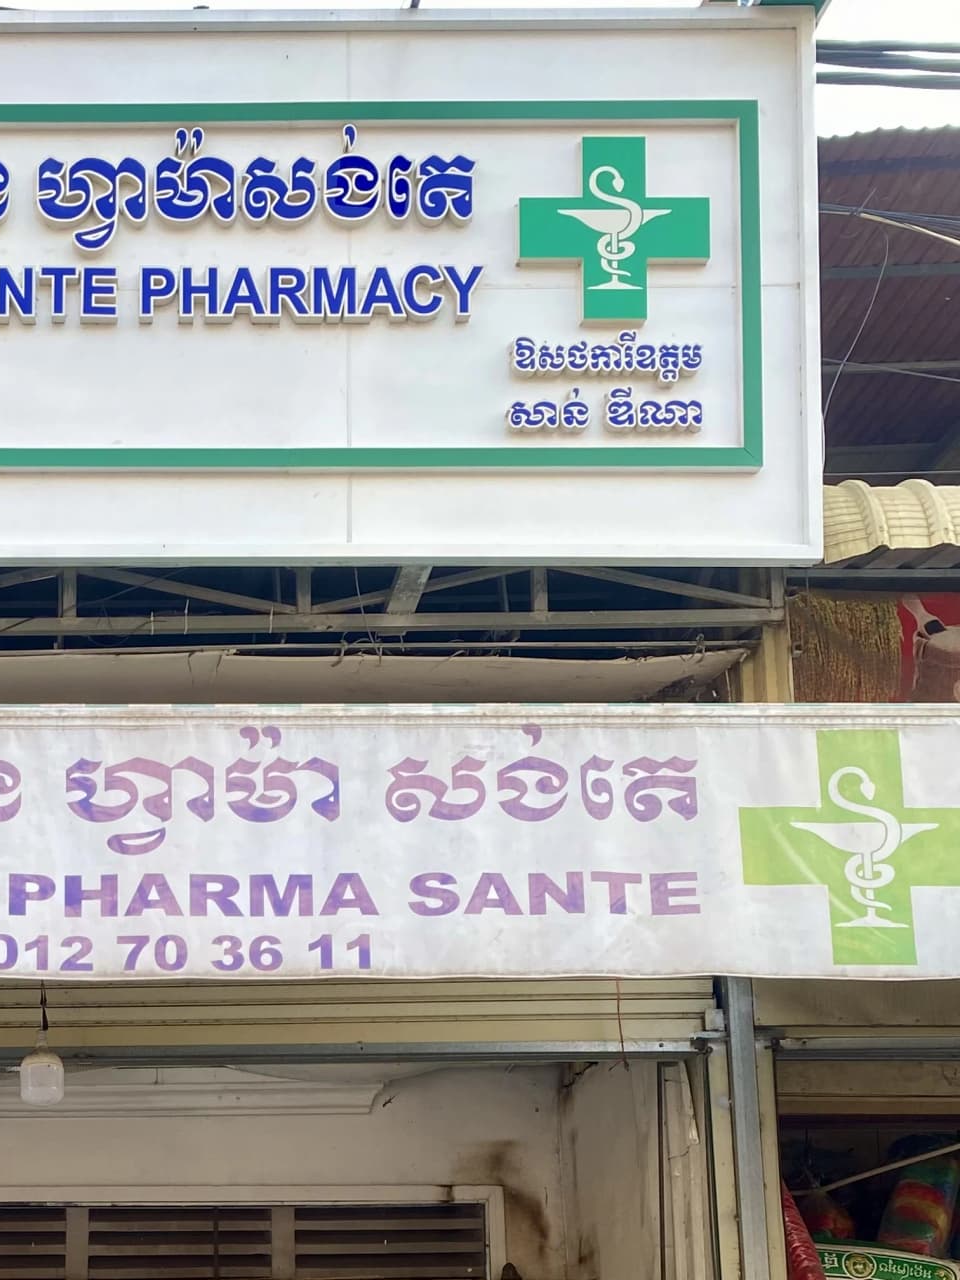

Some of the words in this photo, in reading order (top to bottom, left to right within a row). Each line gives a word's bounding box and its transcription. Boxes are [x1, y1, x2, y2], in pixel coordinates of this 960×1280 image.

[37, 124, 476, 250] ហ្វាម៉ាសង់តេ
[139, 264, 483, 316] PHARMACY
[509, 387, 590, 427] សាន់
[64, 726, 341, 855] ហ្វាម៉ា
[385, 723, 699, 824] សង់តេ
[7, 872, 379, 918] PHARMA
[407, 871, 703, 918] SANTE
[116, 934, 188, 972] 70
[211, 934, 283, 971] 36
[307, 934, 375, 970] 11
